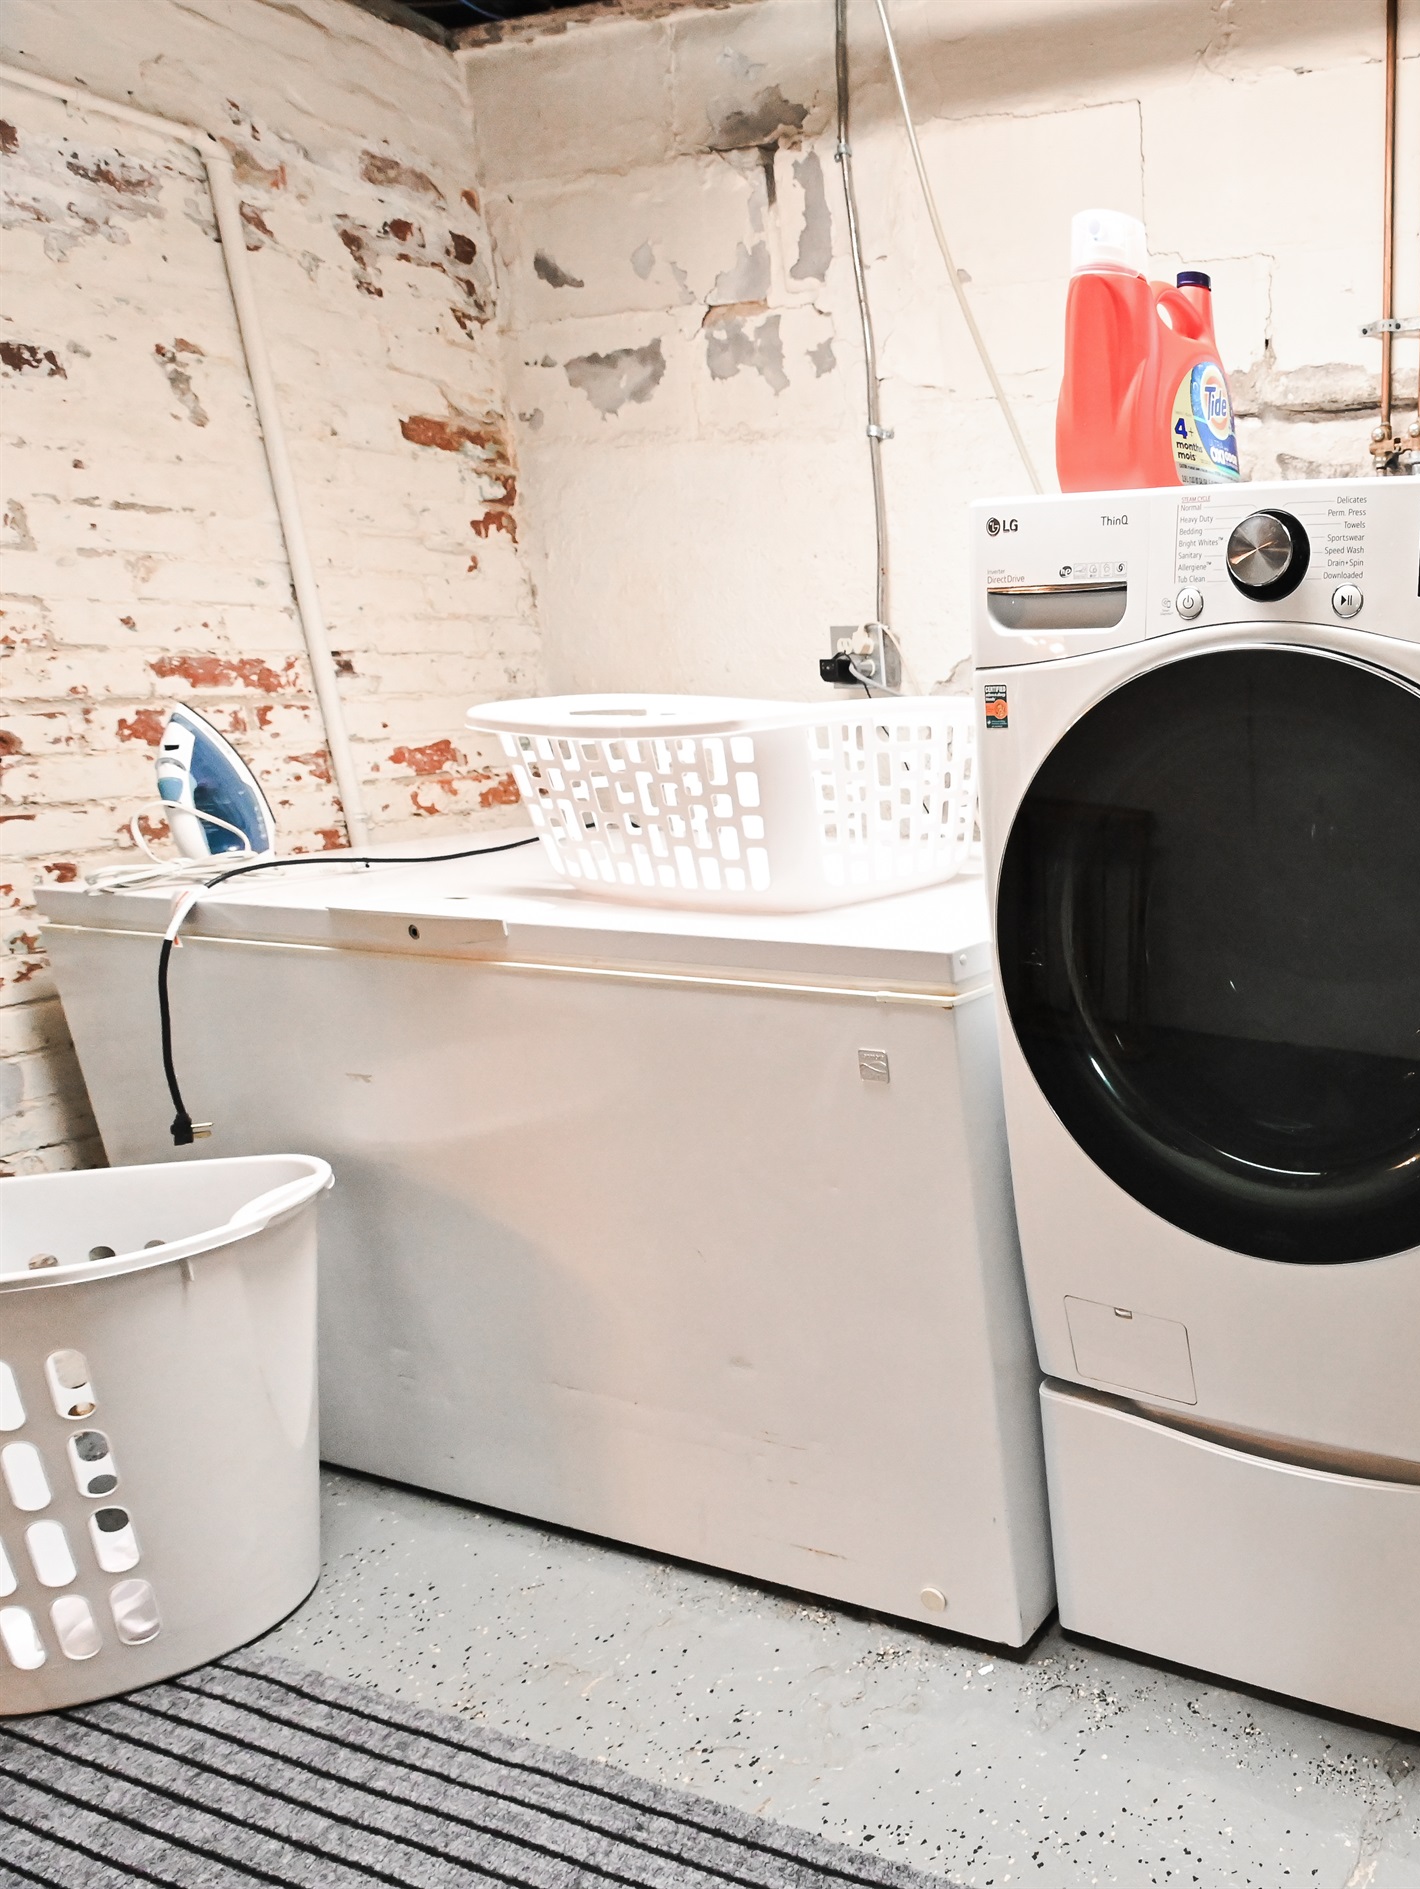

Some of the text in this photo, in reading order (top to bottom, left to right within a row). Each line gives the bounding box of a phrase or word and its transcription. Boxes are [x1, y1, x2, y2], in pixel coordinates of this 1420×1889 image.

[1205, 387, 1226, 420] Tide
[1176, 441, 1203, 454] months
[1178, 451, 1196, 461] mois
[1337, 496, 1367, 504] Delicates
[1327, 508, 1367, 516] Perm. Press
[1101, 514, 1128, 526] ThinQ
[1179, 515, 1214, 524] Heavy Duty
[1002, 519, 1018, 532] LG
[1179, 528, 1203, 536] Bedding
[1327, 533, 1365, 542] Sportswear
[1178, 540, 1197, 549] Bright
[1324, 546, 1365, 556] Speed Wash
[1178, 552, 1202, 560] Sanitary
[1323, 571, 1364, 580] Downloaded
